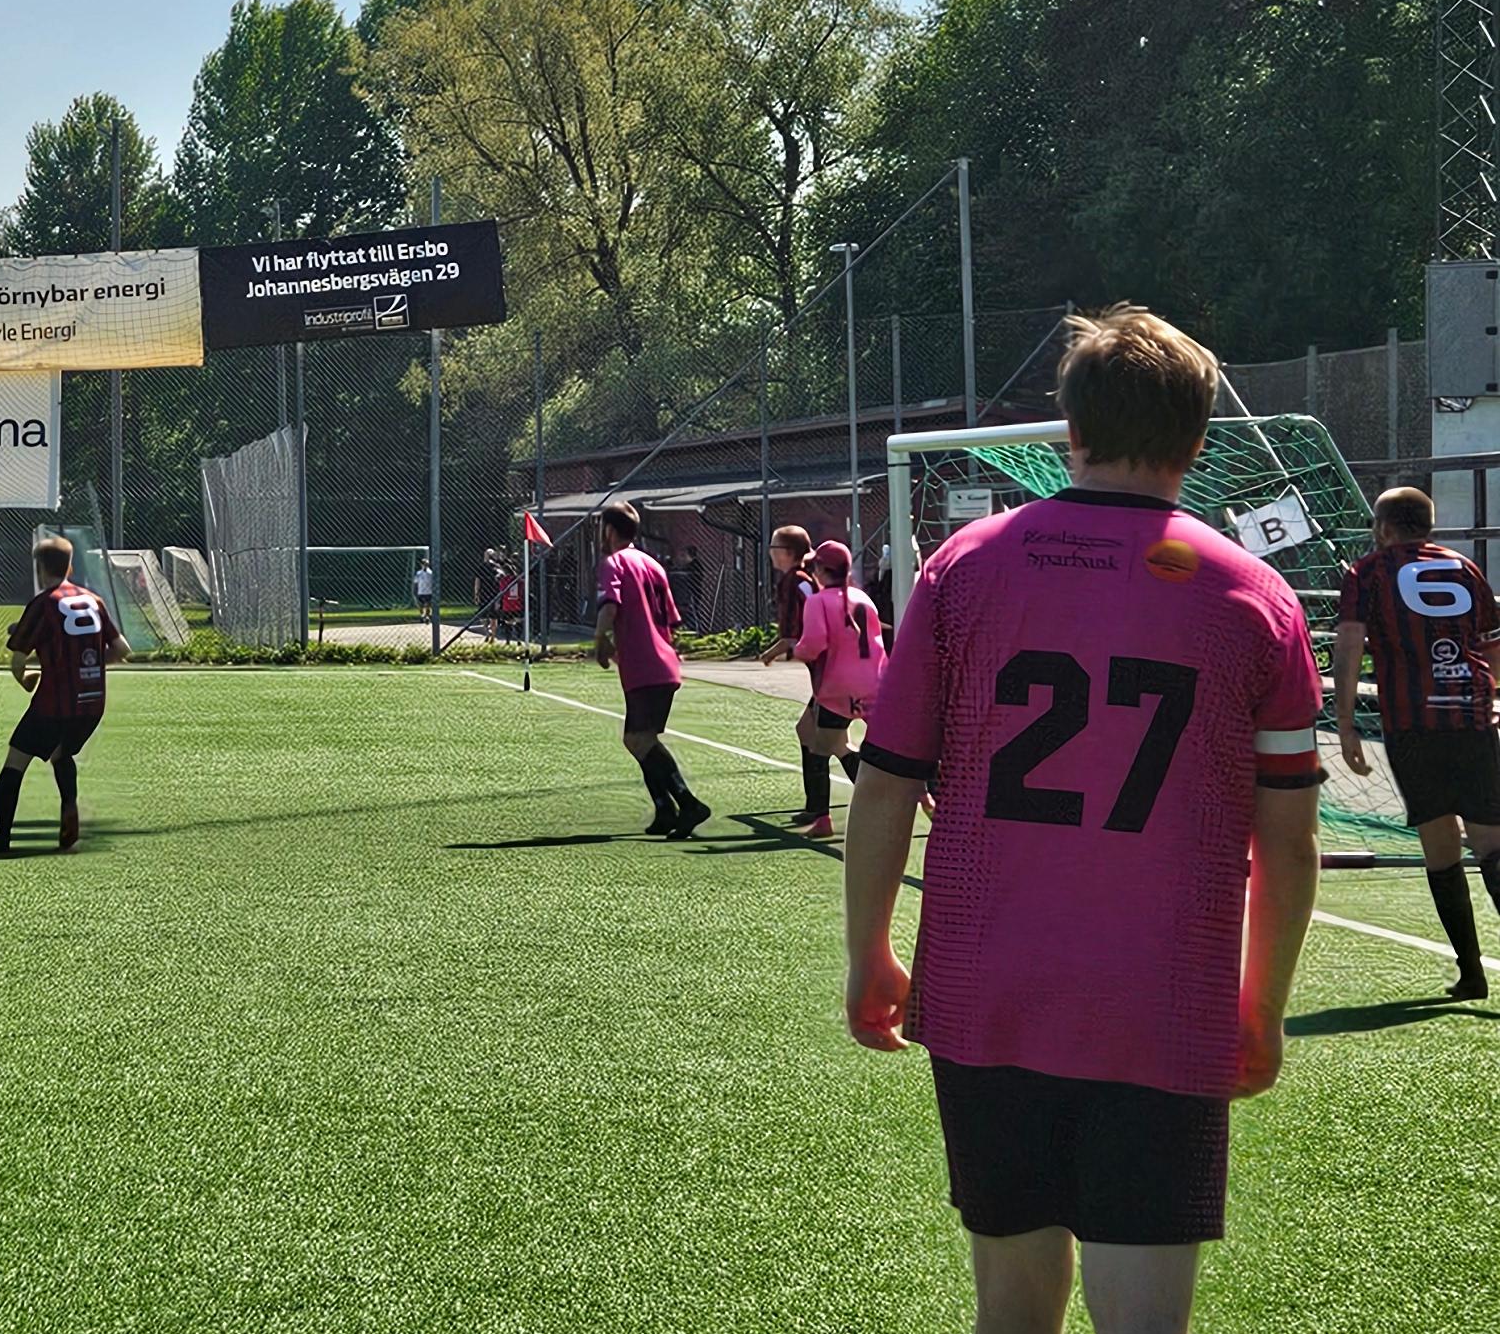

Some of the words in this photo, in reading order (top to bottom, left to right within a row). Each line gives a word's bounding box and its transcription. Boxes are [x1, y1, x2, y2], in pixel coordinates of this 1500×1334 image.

[252, 253, 270, 273] Vi
[274, 254, 303, 271] har
[306, 247, 367, 270] flyttat
[368, 244, 394, 263] till
[397, 240, 449, 260] Ersbo
[93, 277, 166, 300] energi
[246, 267, 433, 298] Johannesbergsvägen
[435, 262, 460, 281] 29
[21, 321, 77, 342] Energi
[1259, 517, 1288, 546] B
[1397, 558, 1472, 617] 6
[58, 594, 101, 635] 8
[984, 649, 1198, 834] 27
